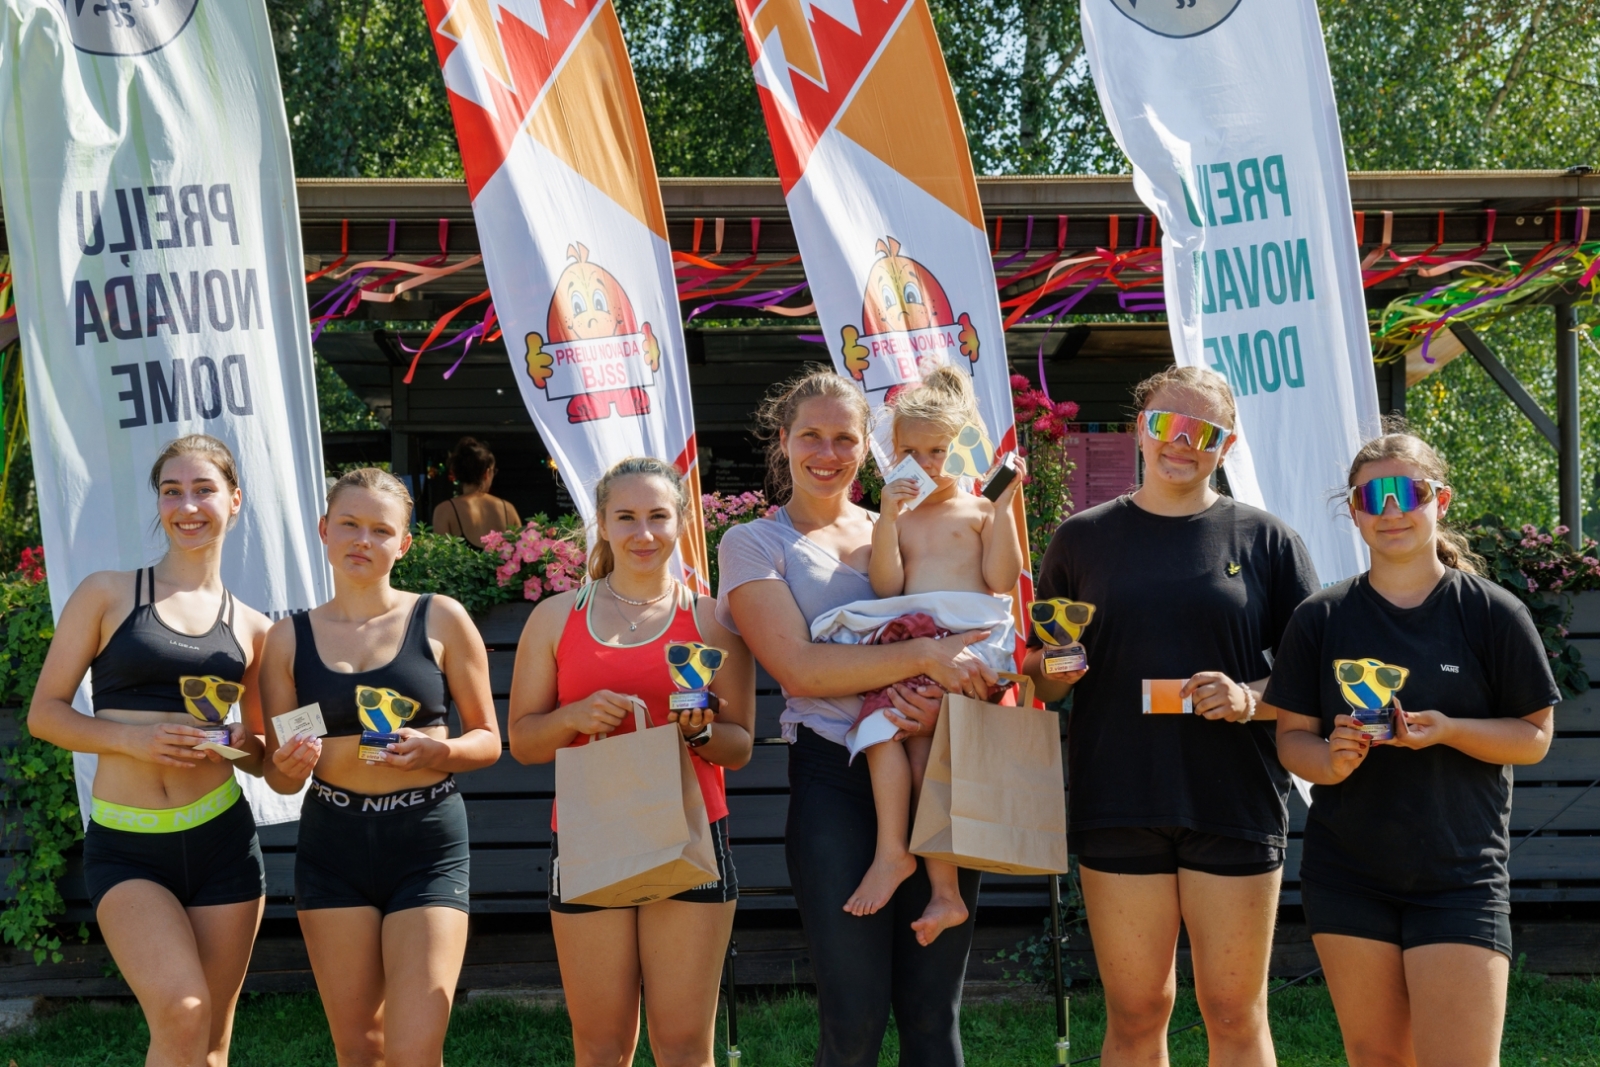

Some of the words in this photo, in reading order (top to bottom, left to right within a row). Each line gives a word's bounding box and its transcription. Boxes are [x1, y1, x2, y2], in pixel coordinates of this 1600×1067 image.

[600, 340, 641, 360] NOVADA
[581, 362, 627, 389] BJSS
[1440, 664, 1460, 674] VANS
[102, 807, 158, 828] PRO
[173, 789, 229, 827] NIKE
[361, 790, 426, 812] NIKE
